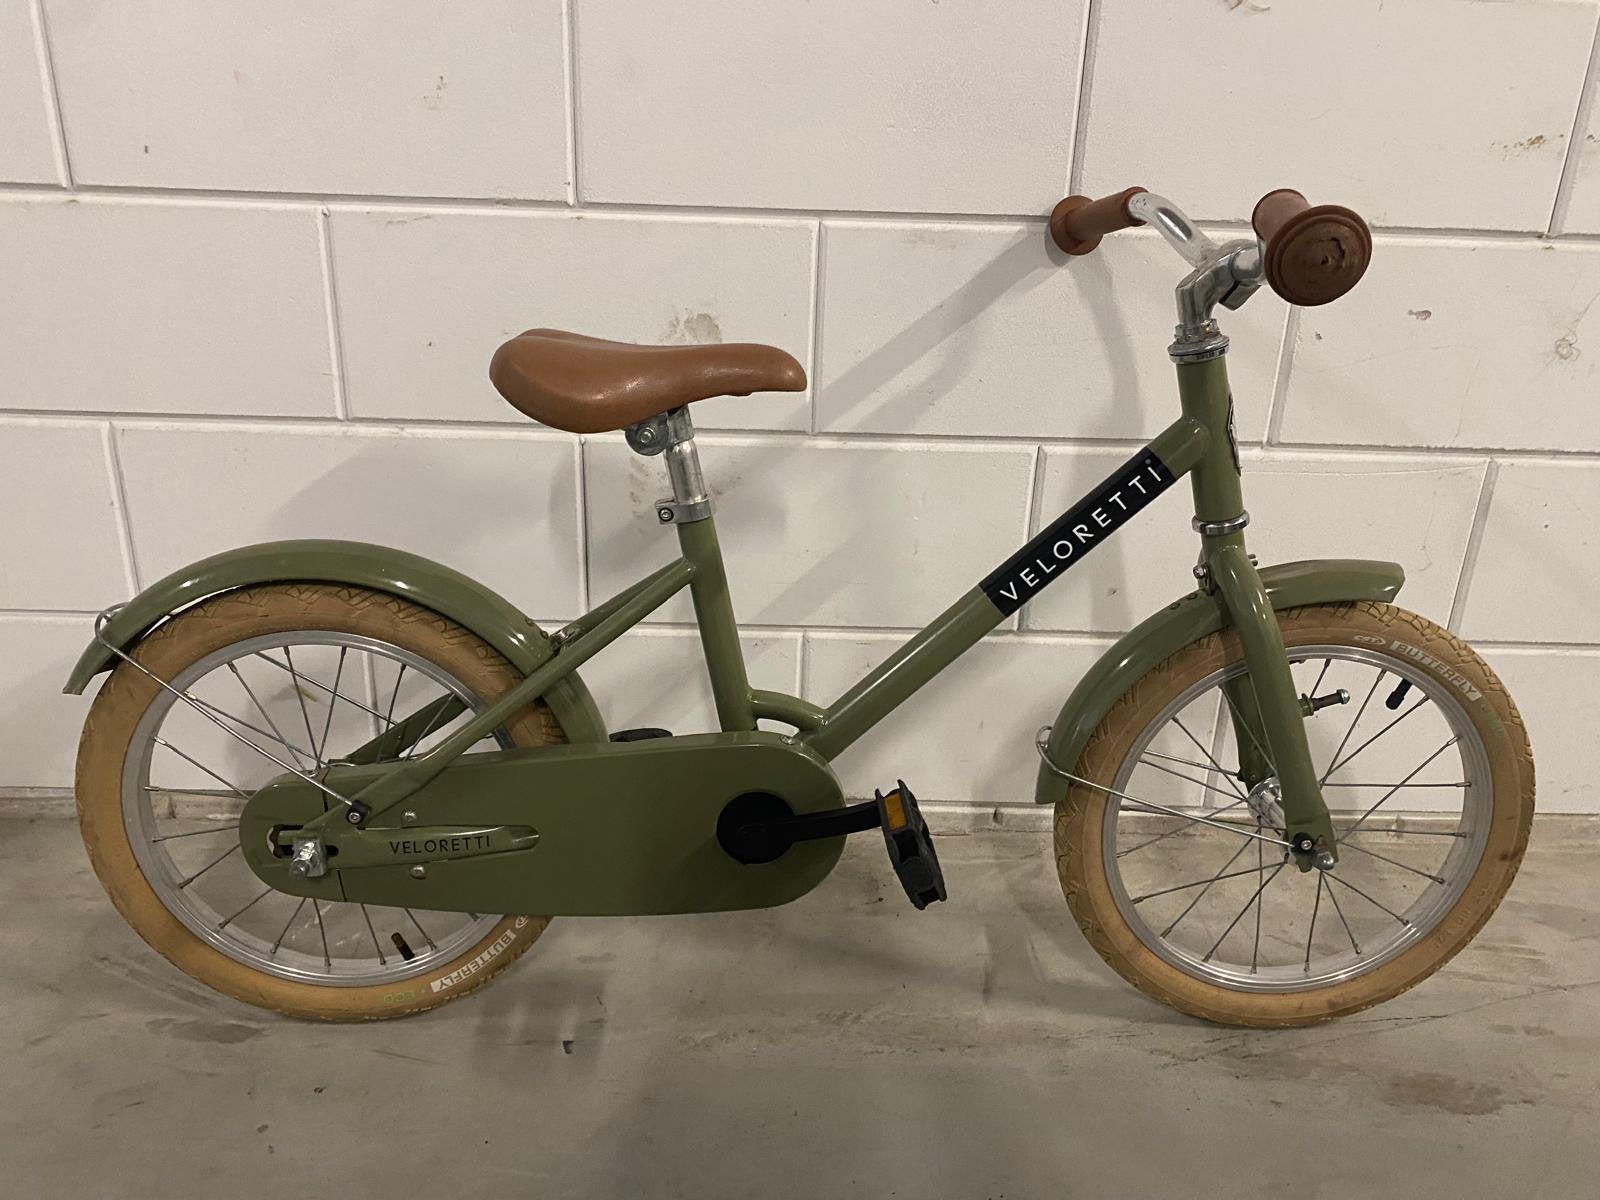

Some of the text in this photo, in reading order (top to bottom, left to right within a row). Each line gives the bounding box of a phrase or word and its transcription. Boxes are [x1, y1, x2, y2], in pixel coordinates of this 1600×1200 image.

[1000, 466, 1161, 600] VELORETTI
[1397, 643, 1478, 697] BUTTERFLY
[389, 835, 490, 854] VELORETTI
[437, 933, 513, 990] BUTTERFLY
